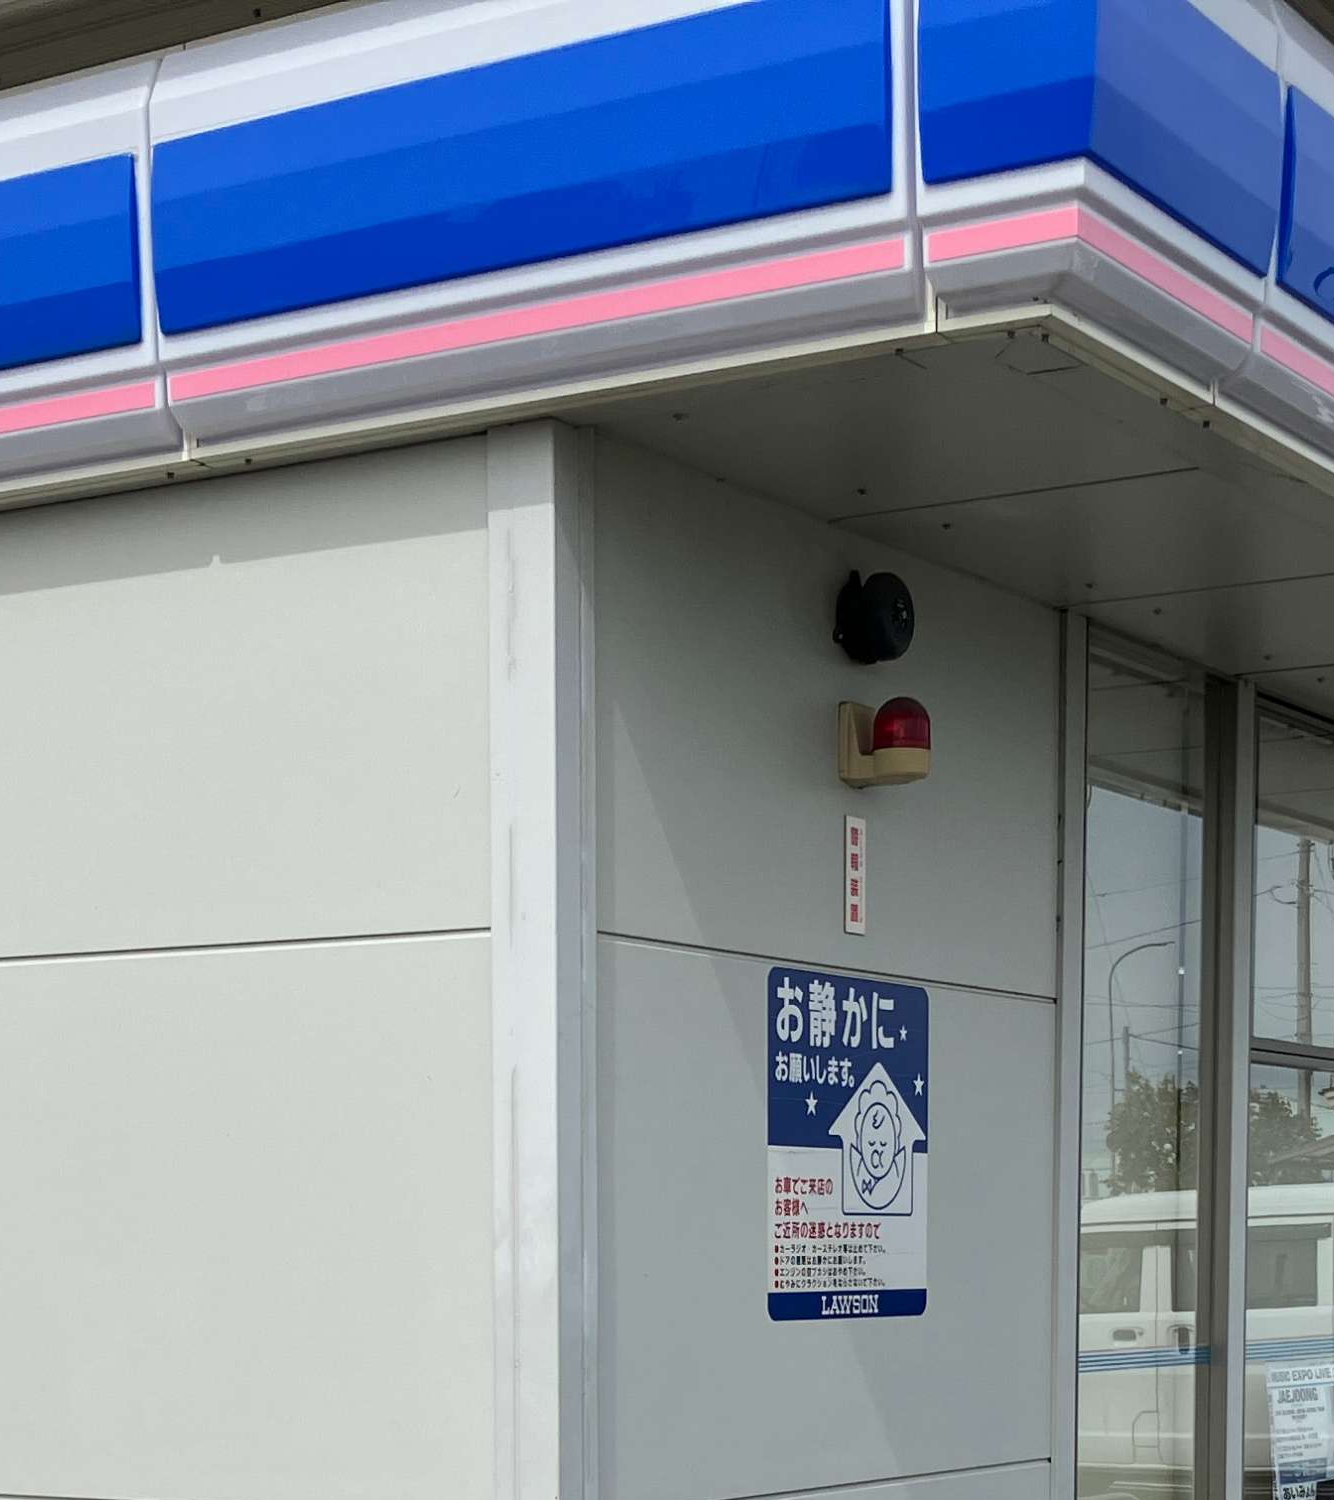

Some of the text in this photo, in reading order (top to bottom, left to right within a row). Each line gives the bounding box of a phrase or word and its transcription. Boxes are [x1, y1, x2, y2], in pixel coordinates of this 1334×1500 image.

[776, 976, 895, 1050] お静かに
[775, 1052, 855, 1088] お願いします。
[774, 1177, 834, 1195] お車でご来店の
[774, 1199, 809, 1217] お客様へ
[774, 1221, 882, 1240] ご近所の迷惑となりますので
[821, 1294, 879, 1315] LAWSON
